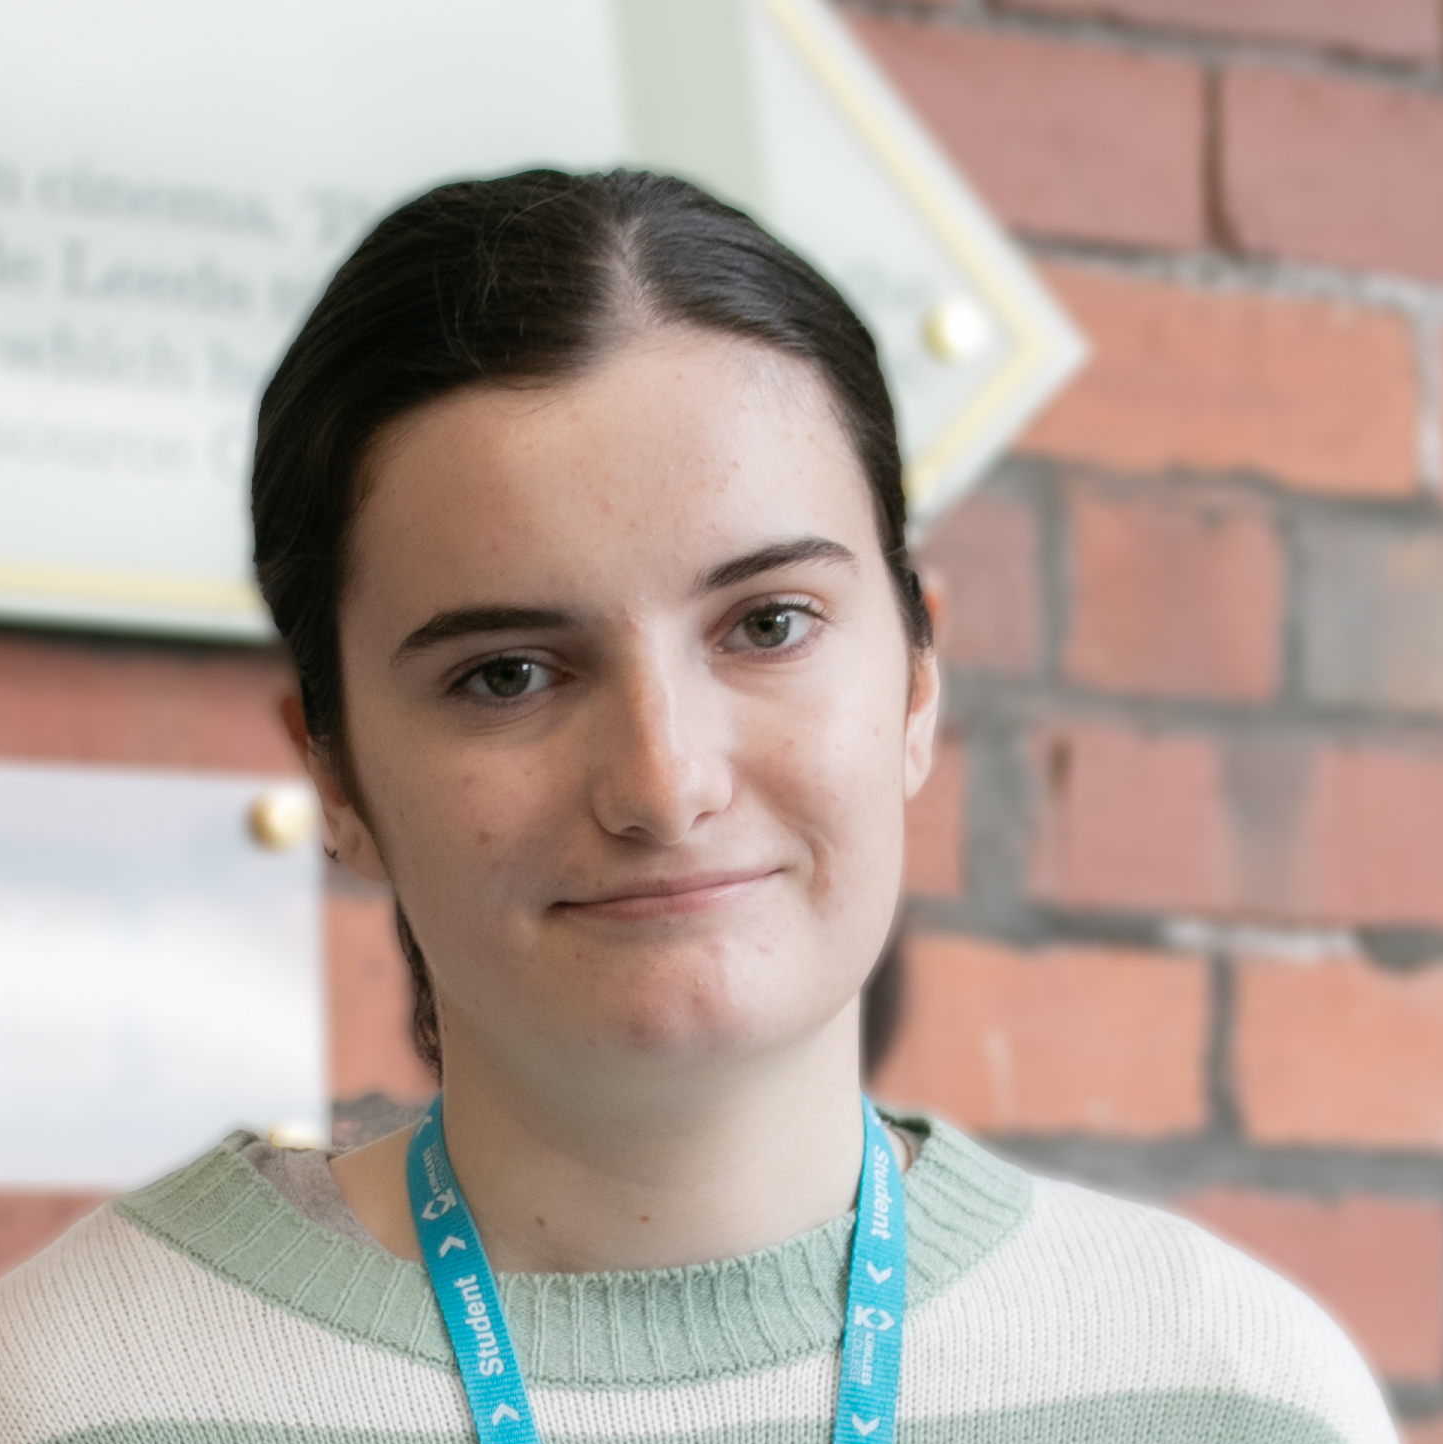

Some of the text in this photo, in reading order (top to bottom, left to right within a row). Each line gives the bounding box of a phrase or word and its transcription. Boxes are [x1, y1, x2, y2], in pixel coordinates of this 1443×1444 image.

[62, 238, 254, 318] Leeds
[870, 1145, 893, 1240] Student
[453, 1273, 505, 1377] Student
